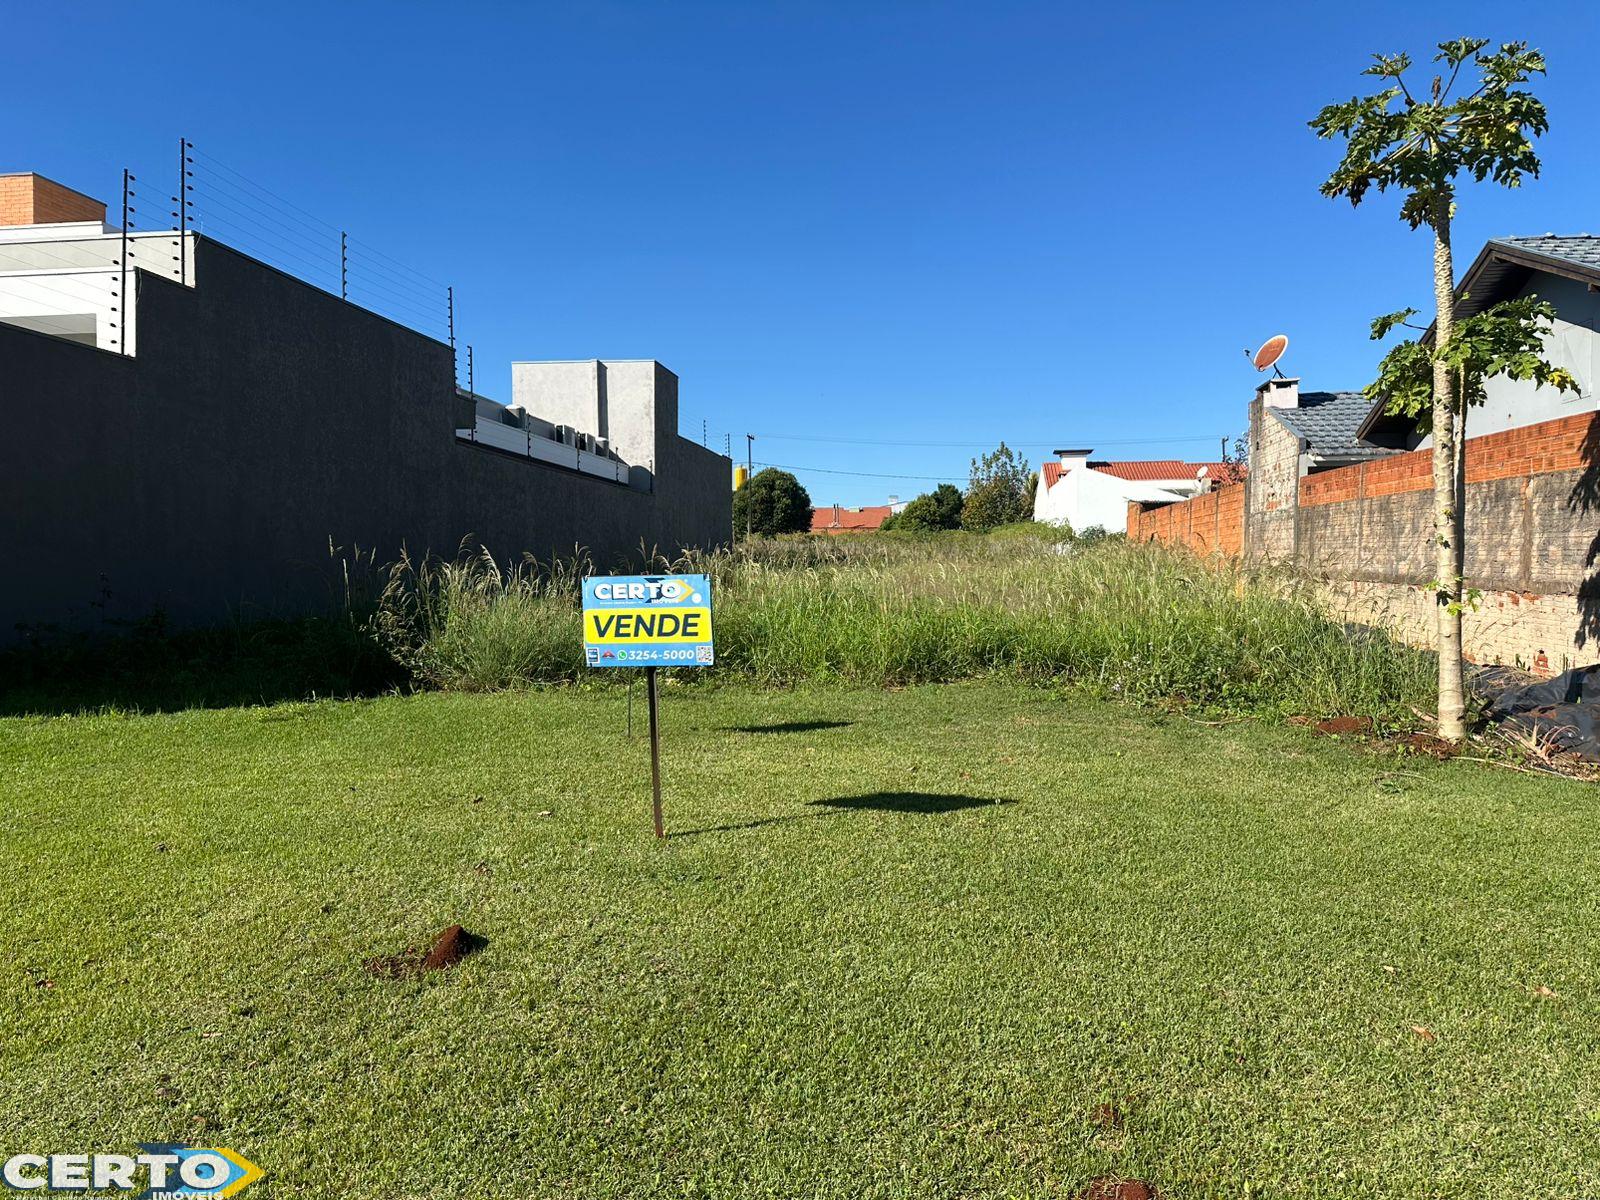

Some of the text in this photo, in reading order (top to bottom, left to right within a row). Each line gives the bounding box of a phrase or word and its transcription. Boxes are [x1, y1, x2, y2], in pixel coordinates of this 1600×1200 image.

[594, 582, 682, 601] CERTO
[593, 613, 701, 638] VENDE
[628, 649, 695, 661] 3254-5000
